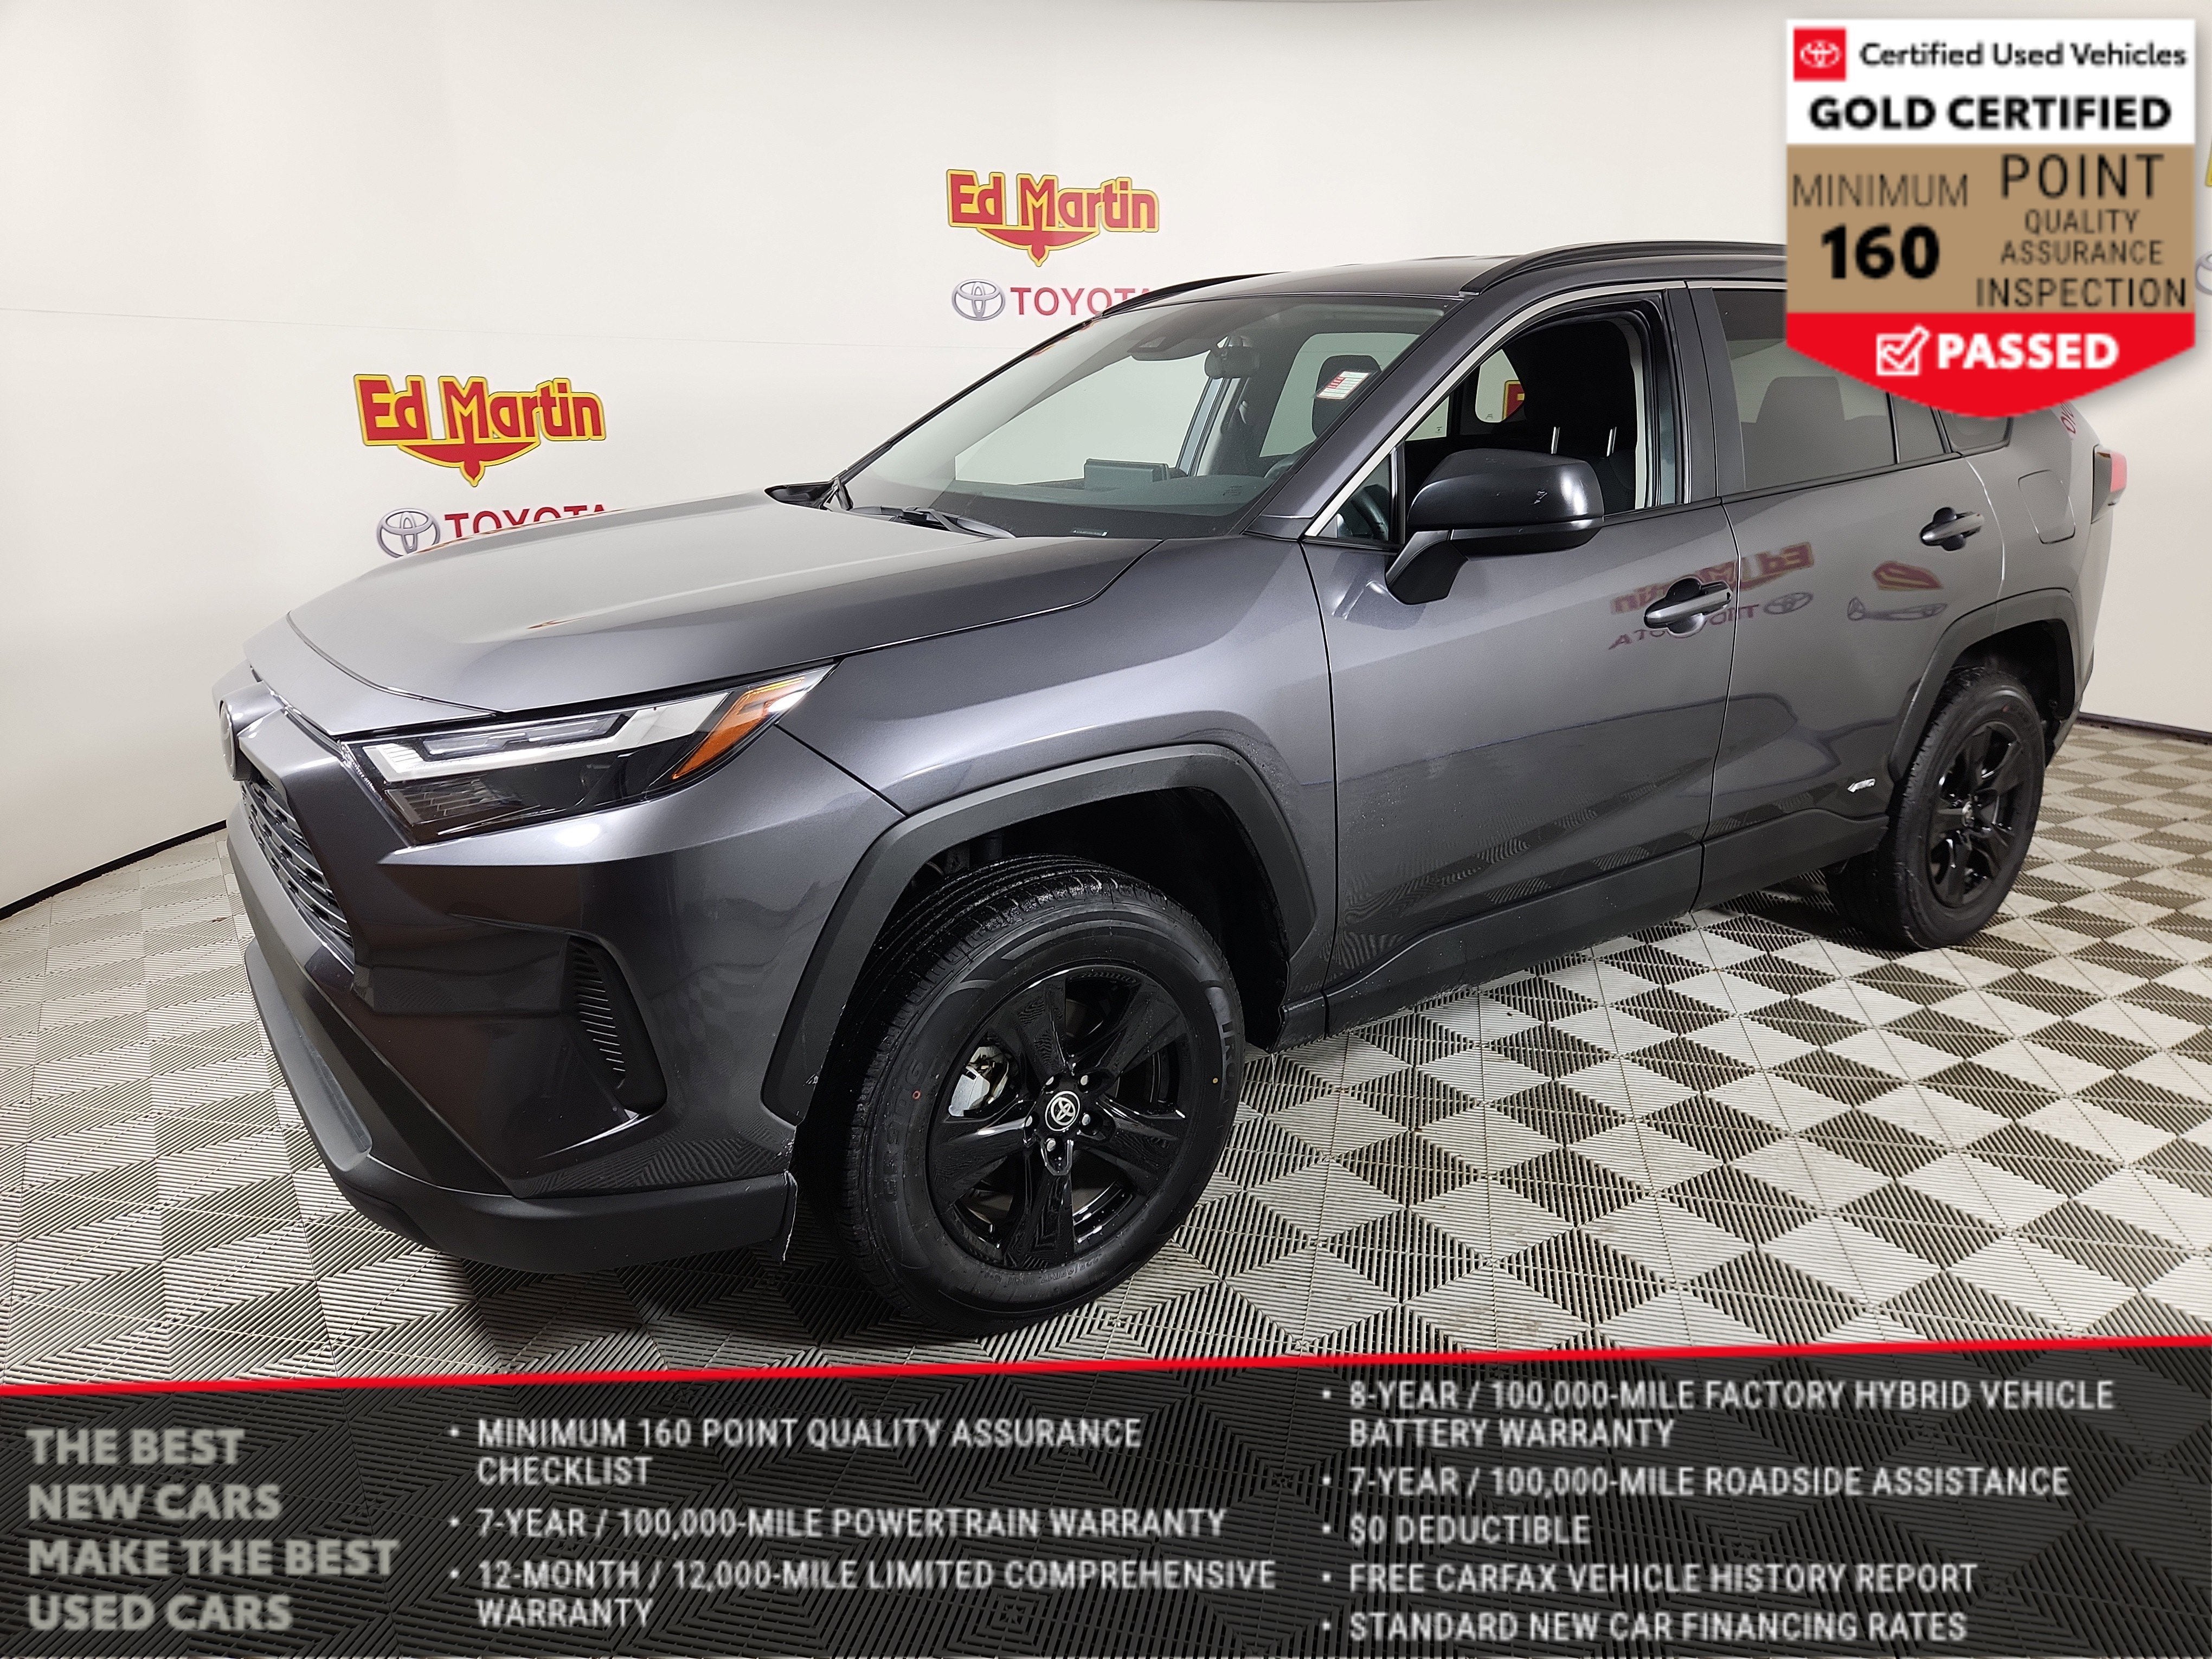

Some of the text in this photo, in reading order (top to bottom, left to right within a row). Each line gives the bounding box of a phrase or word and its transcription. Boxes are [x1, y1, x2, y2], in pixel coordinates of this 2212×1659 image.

[947, 170, 1159, 232] Ed Martin
[1010, 287, 1150, 316] TOYOT
[354, 374, 606, 446] Ed Martin
[445, 504, 607, 538] TOYO
